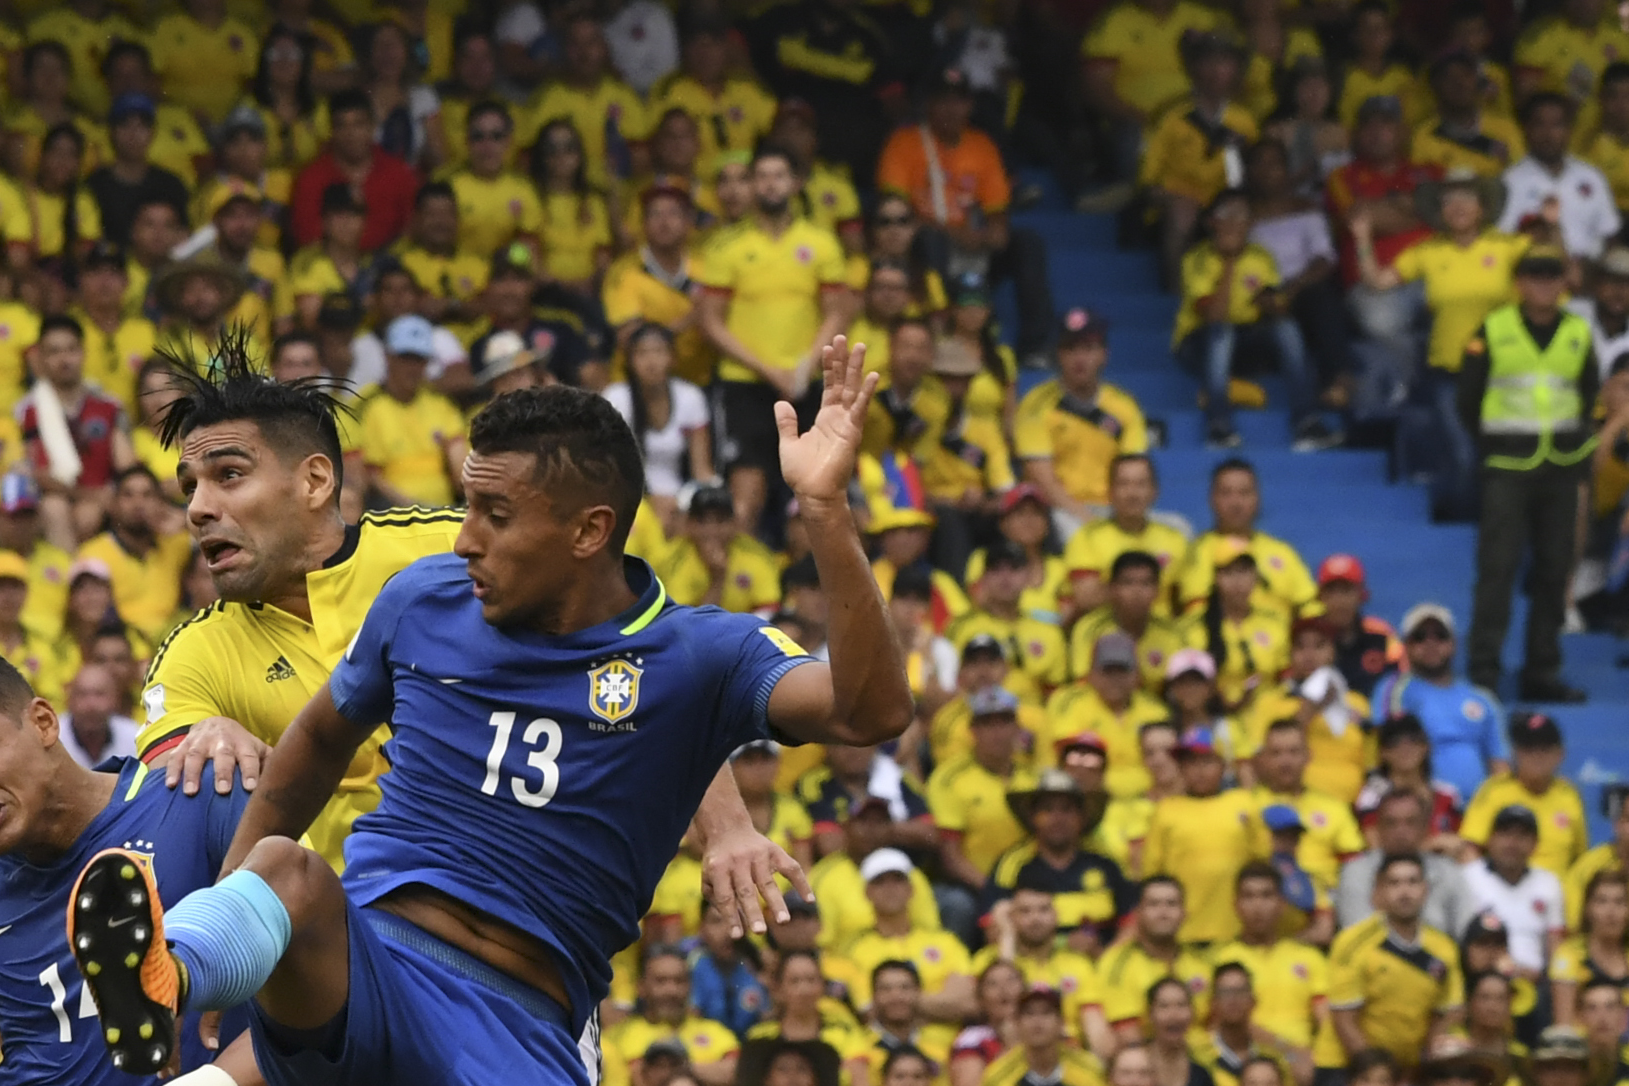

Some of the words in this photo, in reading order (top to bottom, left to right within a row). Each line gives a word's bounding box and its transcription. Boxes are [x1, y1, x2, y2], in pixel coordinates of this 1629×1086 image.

[606, 684, 624, 692] CBF
[588, 721, 638, 732] BRASIL
[481, 711, 563, 808] 13
